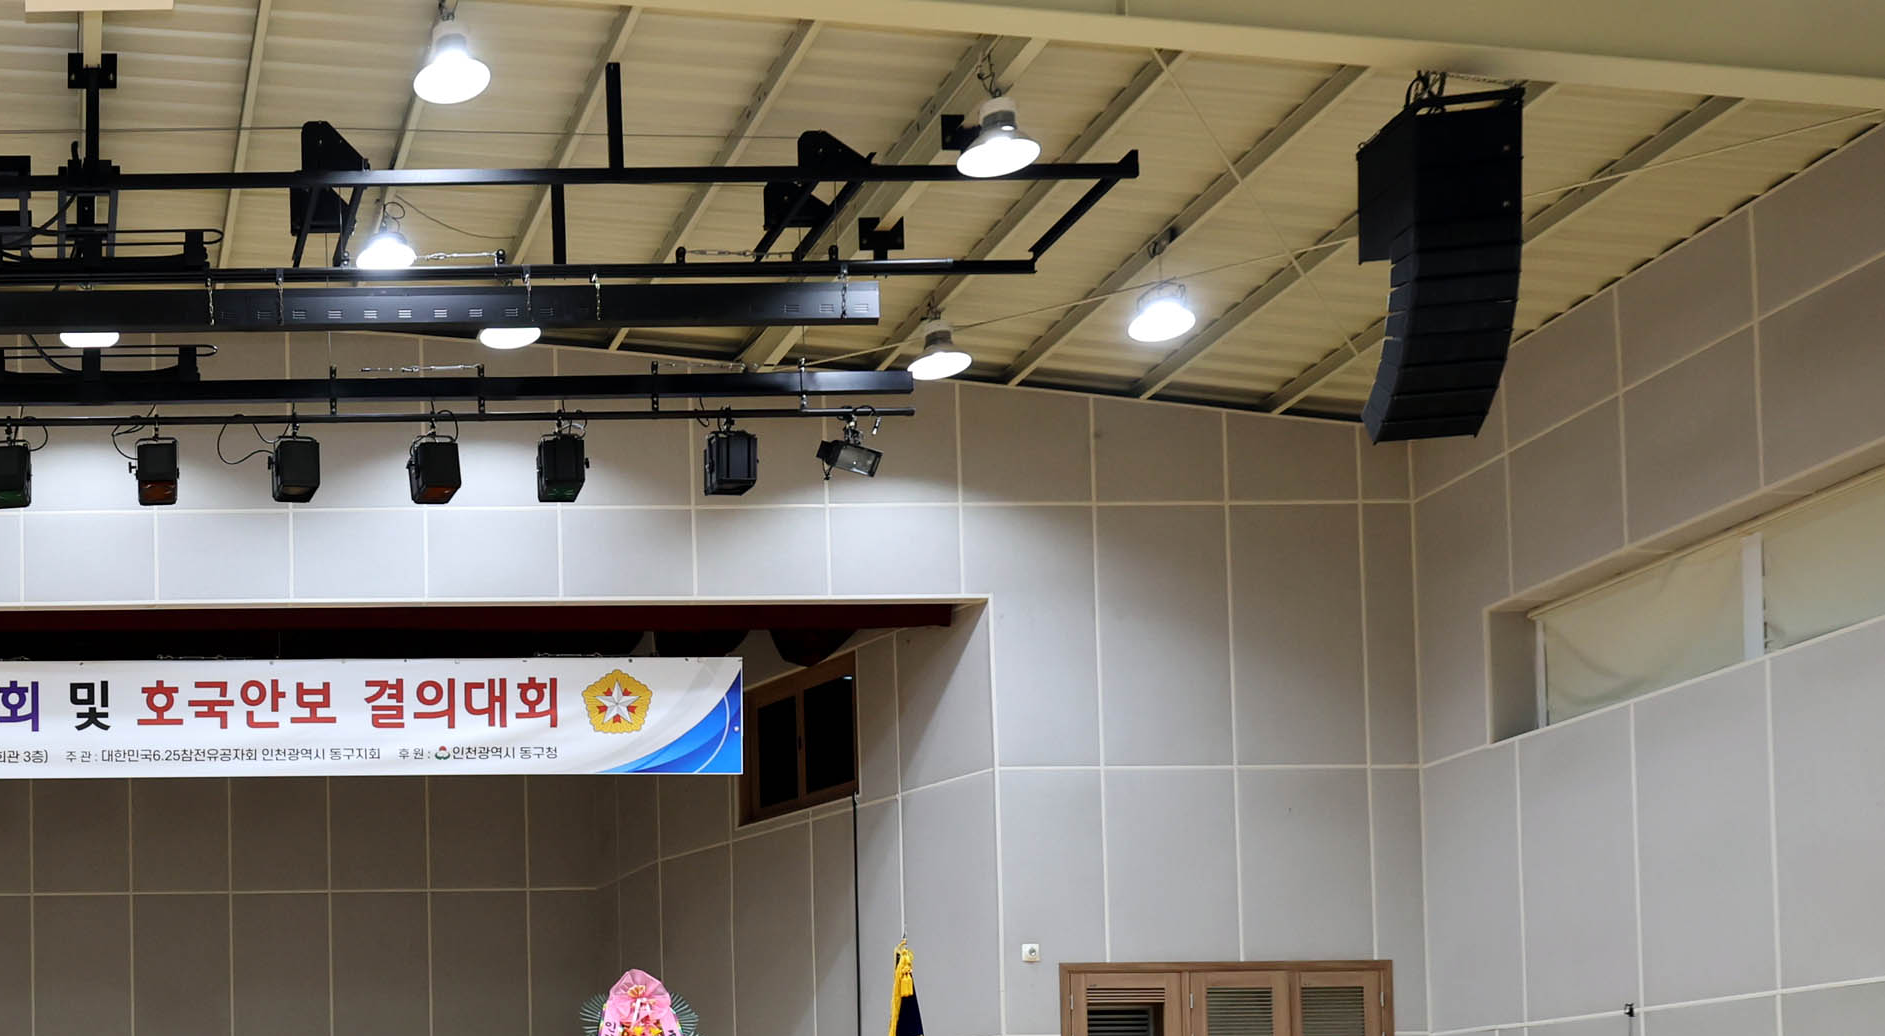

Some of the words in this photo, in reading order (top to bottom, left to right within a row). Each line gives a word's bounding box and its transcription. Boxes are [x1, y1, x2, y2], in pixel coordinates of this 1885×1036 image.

[69, 678, 111, 732] 및
[136, 678, 337, 730] 호국안보
[363, 676, 559, 729] 결의대회
[22, 749, 48, 764] 3층)
[101, 748, 257, 763] 대한민국6.25참전유공자회
[261, 747, 325, 761] 인천광역시
[328, 747, 381, 760] 동구지회
[452, 745, 516, 760] 인천광역시
[519, 746, 558, 759] 동구청
